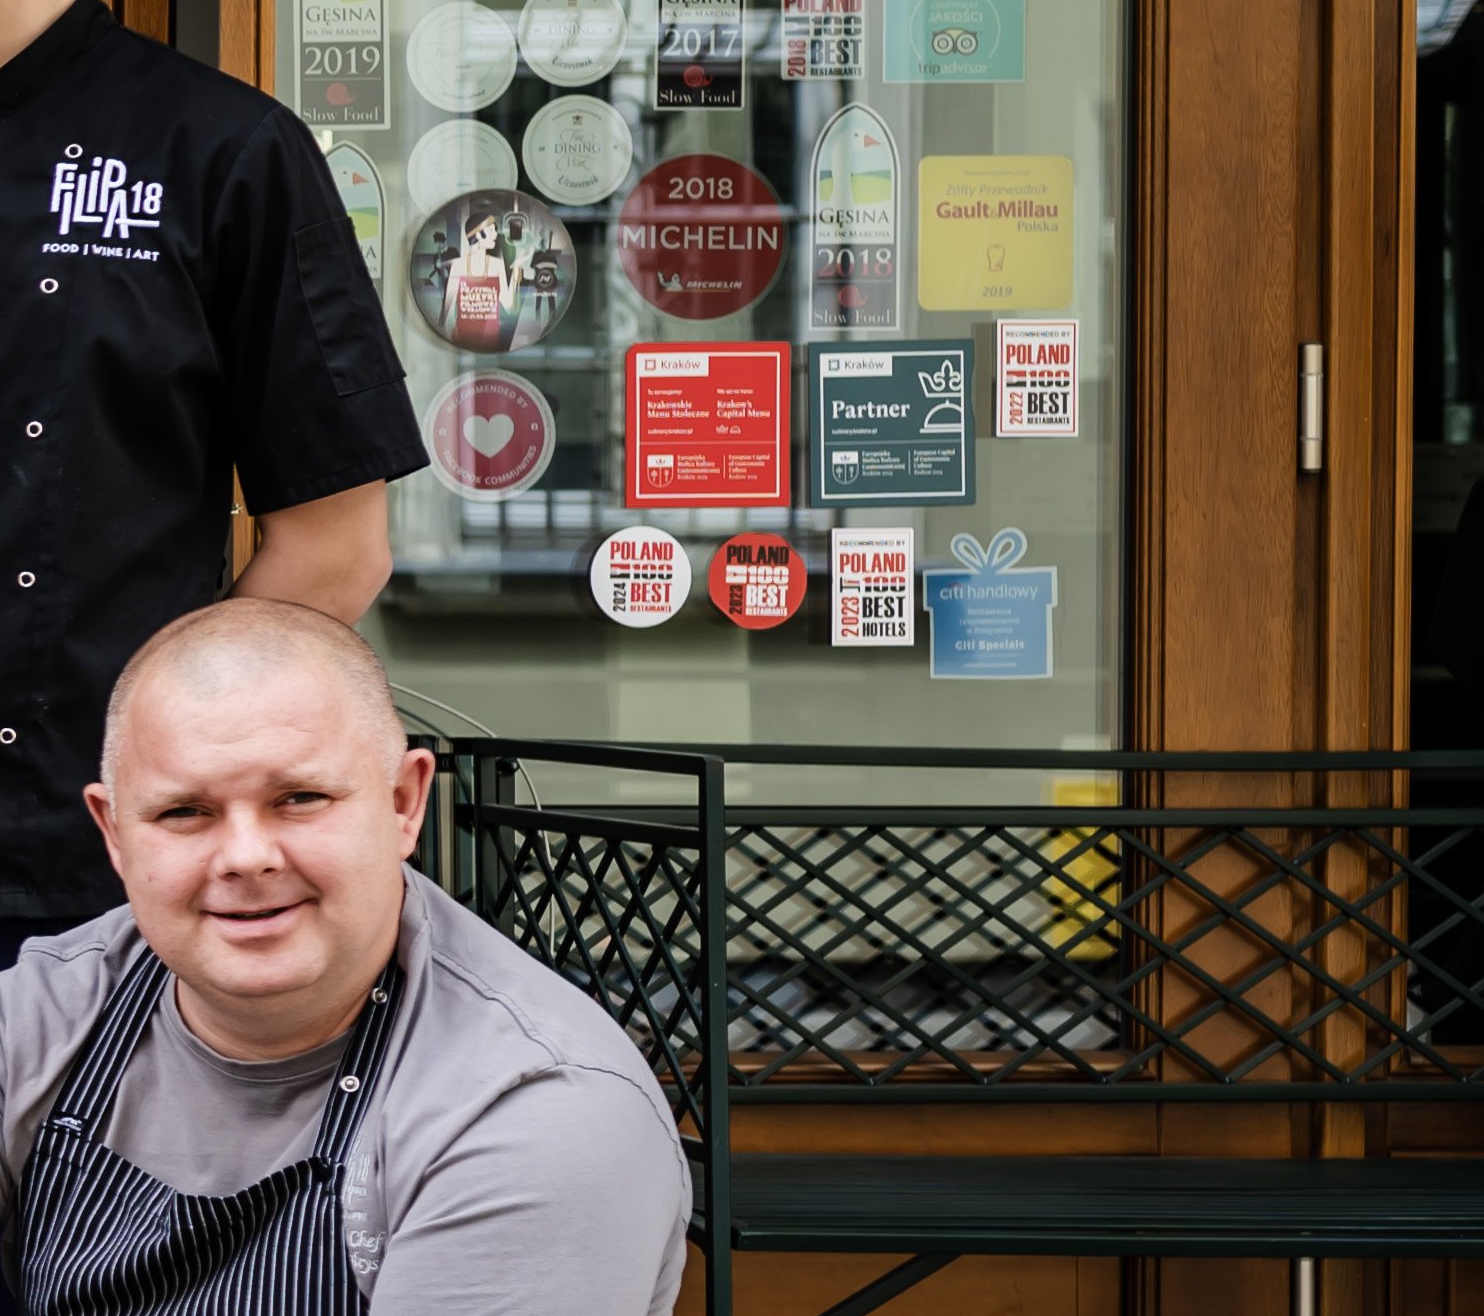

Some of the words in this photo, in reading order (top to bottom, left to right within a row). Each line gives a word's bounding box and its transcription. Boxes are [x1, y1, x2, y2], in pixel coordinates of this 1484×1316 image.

[811, 16, 862, 36] 100
[663, 28, 738, 57] 2017
[810, 39, 862, 65] BEST
[304, 46, 381, 75] 2019
[659, 89, 692, 104] Slow
[303, 107, 335, 121] Slow
[554, 143, 601, 154] DINING
[130, 180, 163, 214] 18
[668, 177, 734, 200] 2018
[1017, 221, 1058, 232] Polska
[622, 225, 778, 251] MICHELIN
[42, 243, 79, 253] FOOD
[91, 244, 123, 257] WINE
[132, 249, 160, 262] ART
[817, 248, 893, 277] 2018
[982, 286, 1013, 298] 2019
[661, 359, 700, 369] Kraków
[1006, 344, 1070, 364] POLAND
[844, 360, 884, 369] Kraków
[1029, 370, 1070, 387] 100
[832, 400, 910, 419] Partner
[1009, 392, 1023, 425] 2022
[1027, 392, 1070, 414] BEST
[610, 541, 673, 560] POLAND
[727, 545, 789, 564] POLAND
[633, 564, 672, 580] 100
[840, 553, 906, 573] POLAND
[748, 565, 789, 584] 100
[863, 577, 905, 592] 100
[613, 583, 626, 612] 2024
[630, 583, 672, 603] BEST
[746, 584, 788, 607] BEST
[967, 584, 1038, 600] handlowy
[841, 596, 859, 637] 2023
[862, 597, 905, 618] BEST
[862, 622, 905, 637] HOTELS
[350, 1230, 385, 1253] Chef
